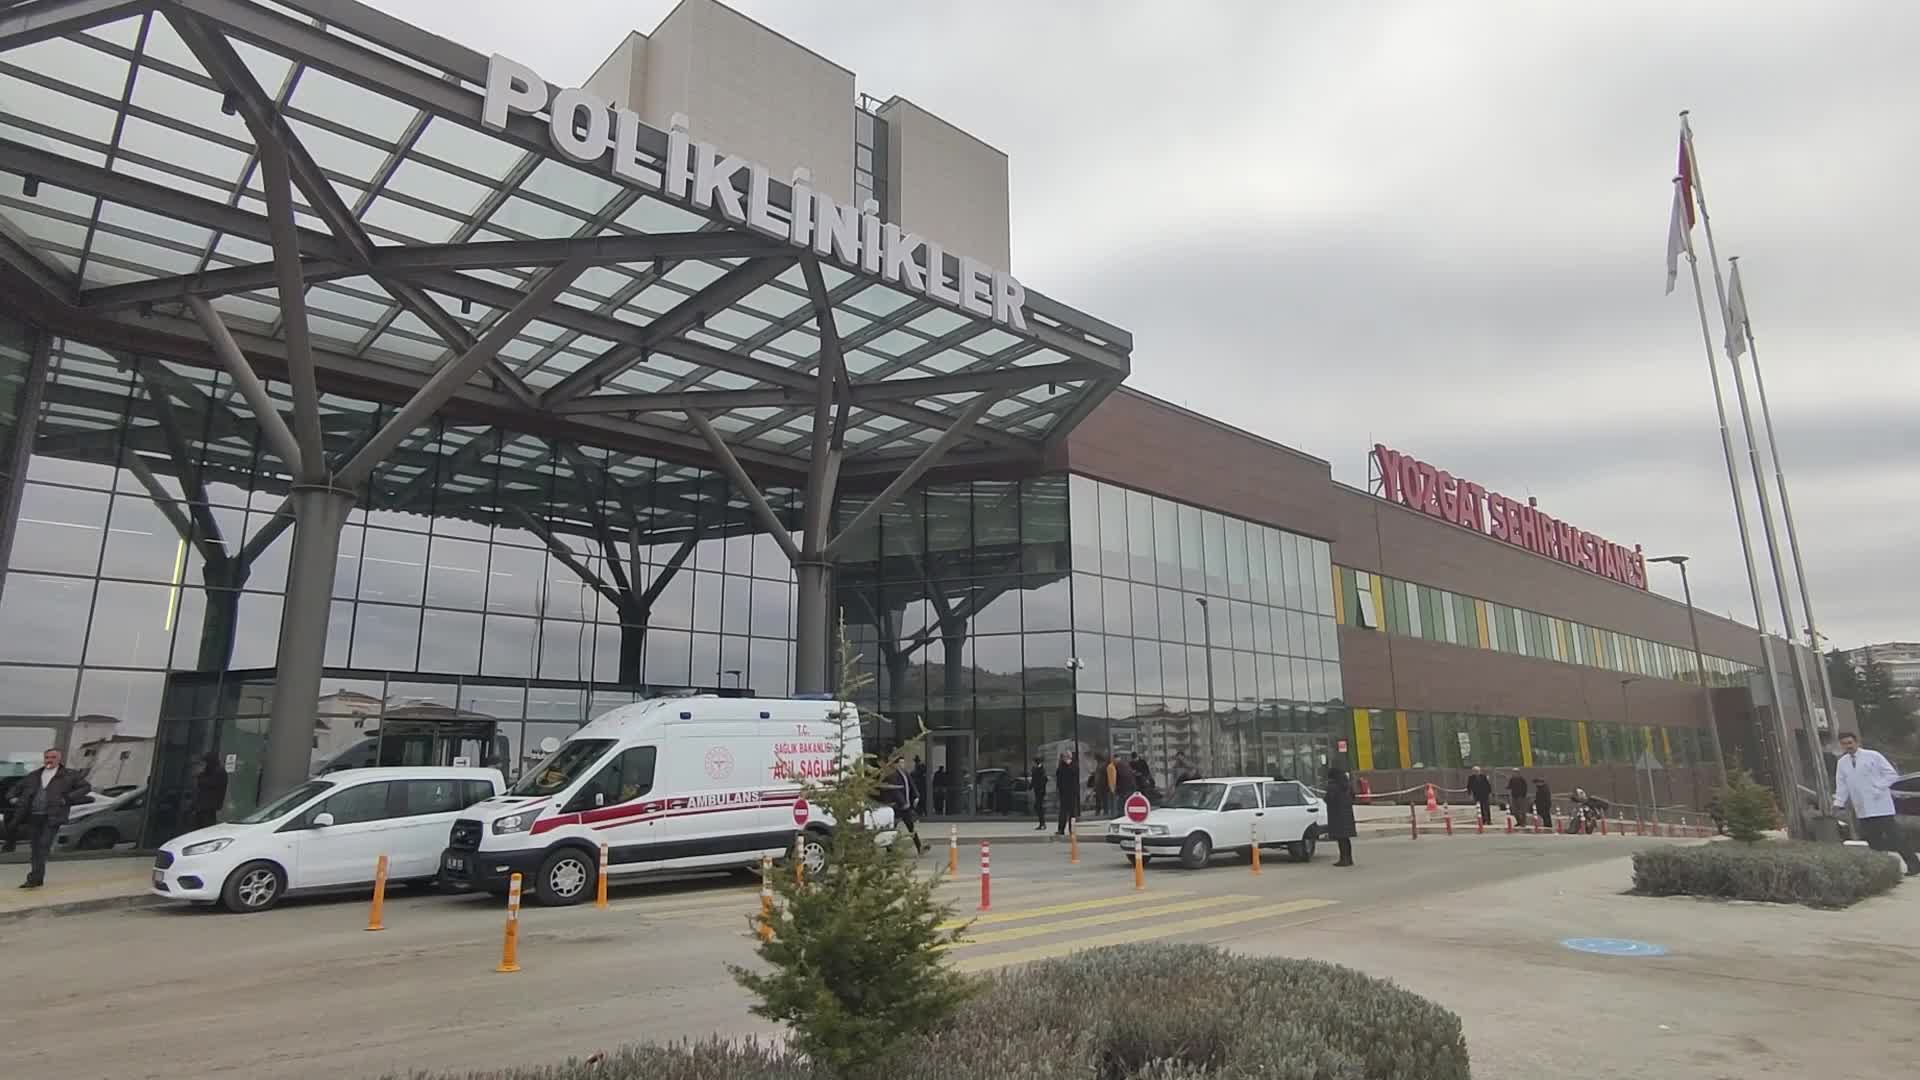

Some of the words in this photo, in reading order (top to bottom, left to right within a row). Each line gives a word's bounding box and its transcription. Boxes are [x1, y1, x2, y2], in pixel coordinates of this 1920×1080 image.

[482, 52, 1027, 330] POLİKLİNİKLER
[1374, 443, 1486, 533] YOZGAT
[1553, 519, 1648, 591] HASTANESİ
[686, 791, 760, 808] AMBULANS
